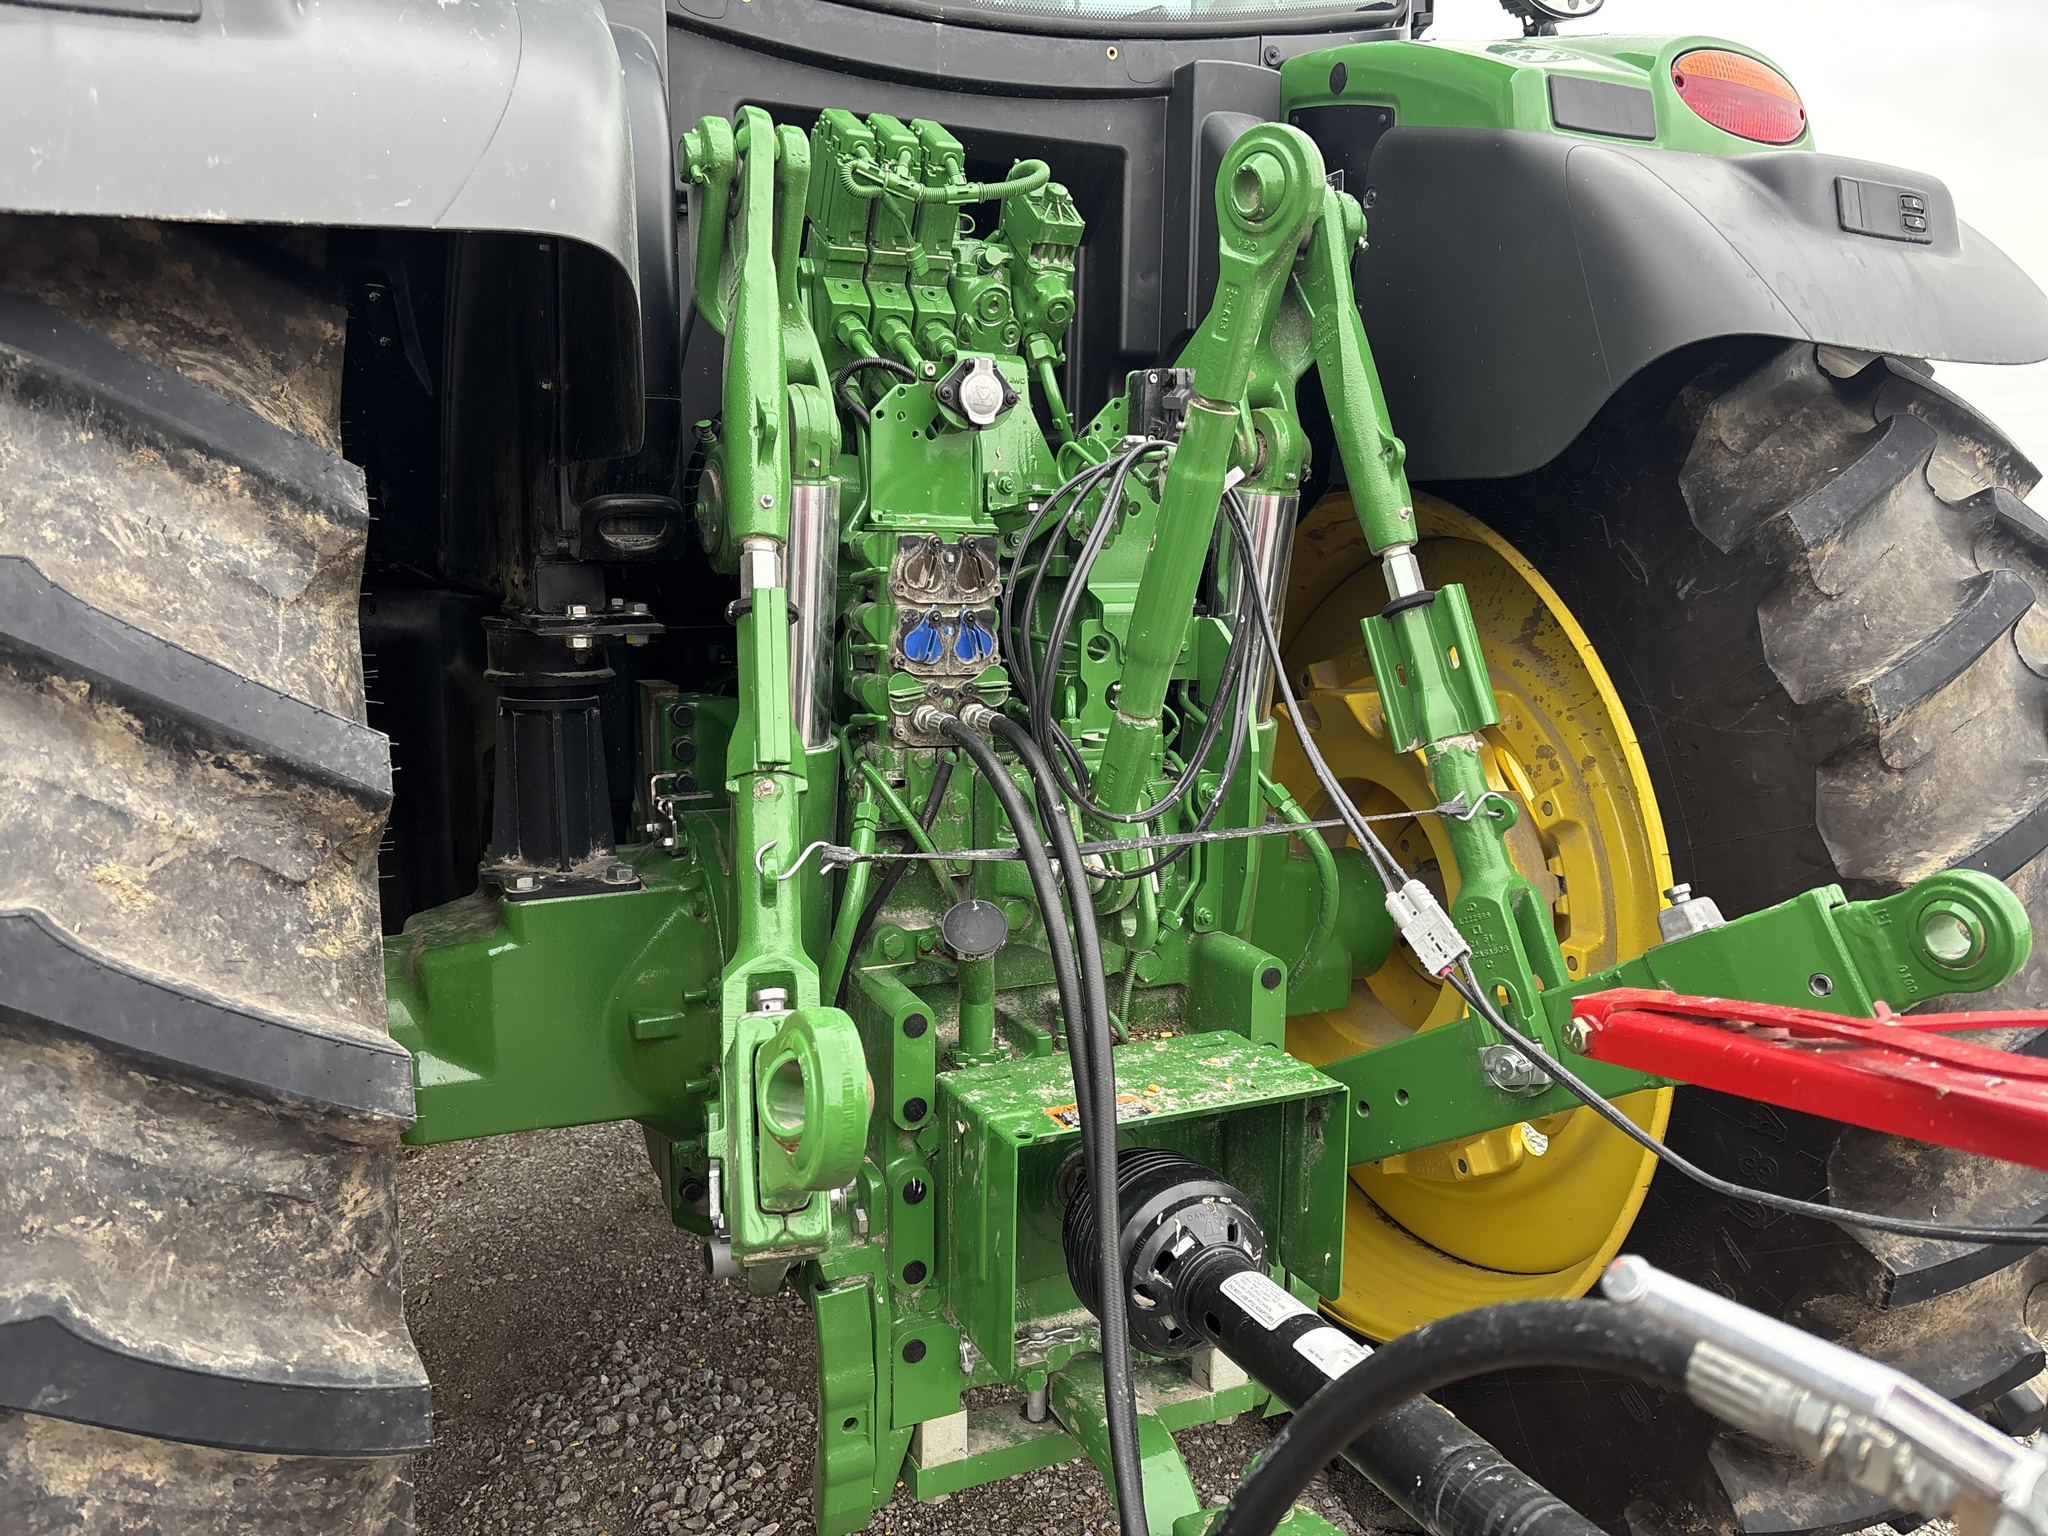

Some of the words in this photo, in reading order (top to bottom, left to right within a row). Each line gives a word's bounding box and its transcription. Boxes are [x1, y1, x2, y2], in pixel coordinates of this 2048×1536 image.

[1187, 1209, 1224, 1222] DANGER
[1233, 1287, 1241, 1295] NOT
[1239, 1293, 1248, 1301] USE
[1247, 1299, 1256, 1307] PTO
[1254, 1304, 1274, 1322] ADAPTORS
